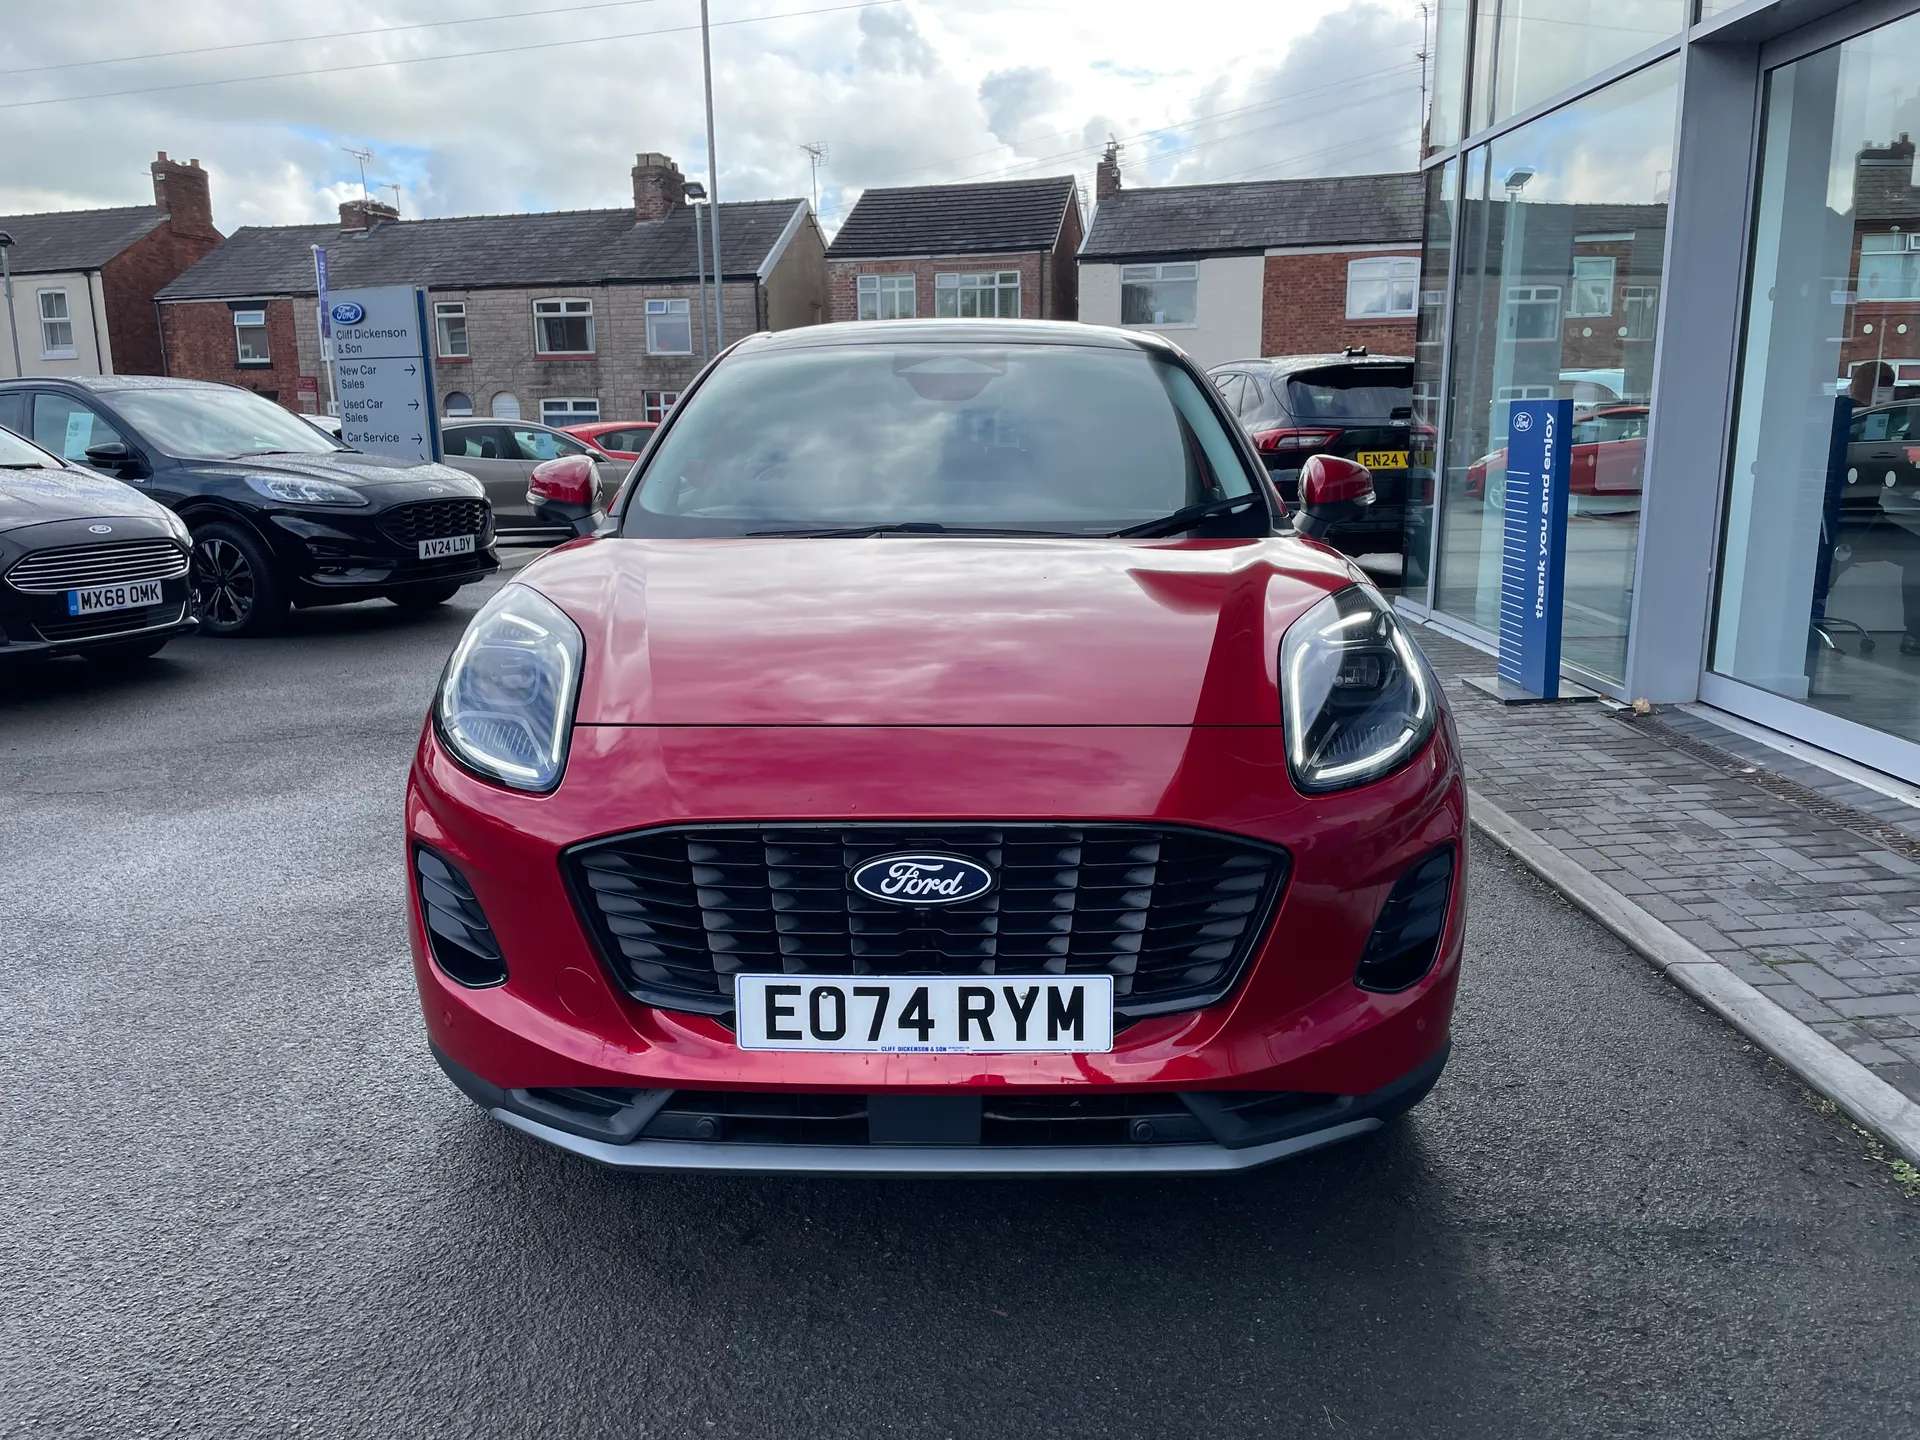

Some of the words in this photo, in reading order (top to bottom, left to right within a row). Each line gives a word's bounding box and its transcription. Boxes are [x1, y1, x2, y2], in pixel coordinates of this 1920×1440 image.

[336, 305, 357, 320] Ford
[336, 329, 353, 341] Cliff
[354, 328, 407, 339] Dickenson
[338, 344, 344, 353] &
[345, 343, 363, 354] Son
[340, 365, 358, 376] New
[360, 364, 377, 375] Car
[341, 379, 365, 389] Sales
[343, 399, 365, 409] Used
[366, 398, 383, 409] Car
[345, 412, 369, 423] Sales
[347, 432, 361, 442] Car
[363, 431, 400, 443] Service
[1543, 412, 1555, 470] enjoy
[1363, 453, 1400, 467] EN24
[1541, 473, 1550, 515] and
[1539, 518, 1548, 557] you
[424, 539, 451, 557] AV24
[453, 536, 471, 552] LDY
[1535, 559, 1546, 619] thank
[81, 587, 126, 611] MX68
[129, 583, 160, 603] OMK
[880, 861, 965, 895] Ford
[765, 985, 935, 1041] EO74
[958, 986, 1085, 1042] RYM
